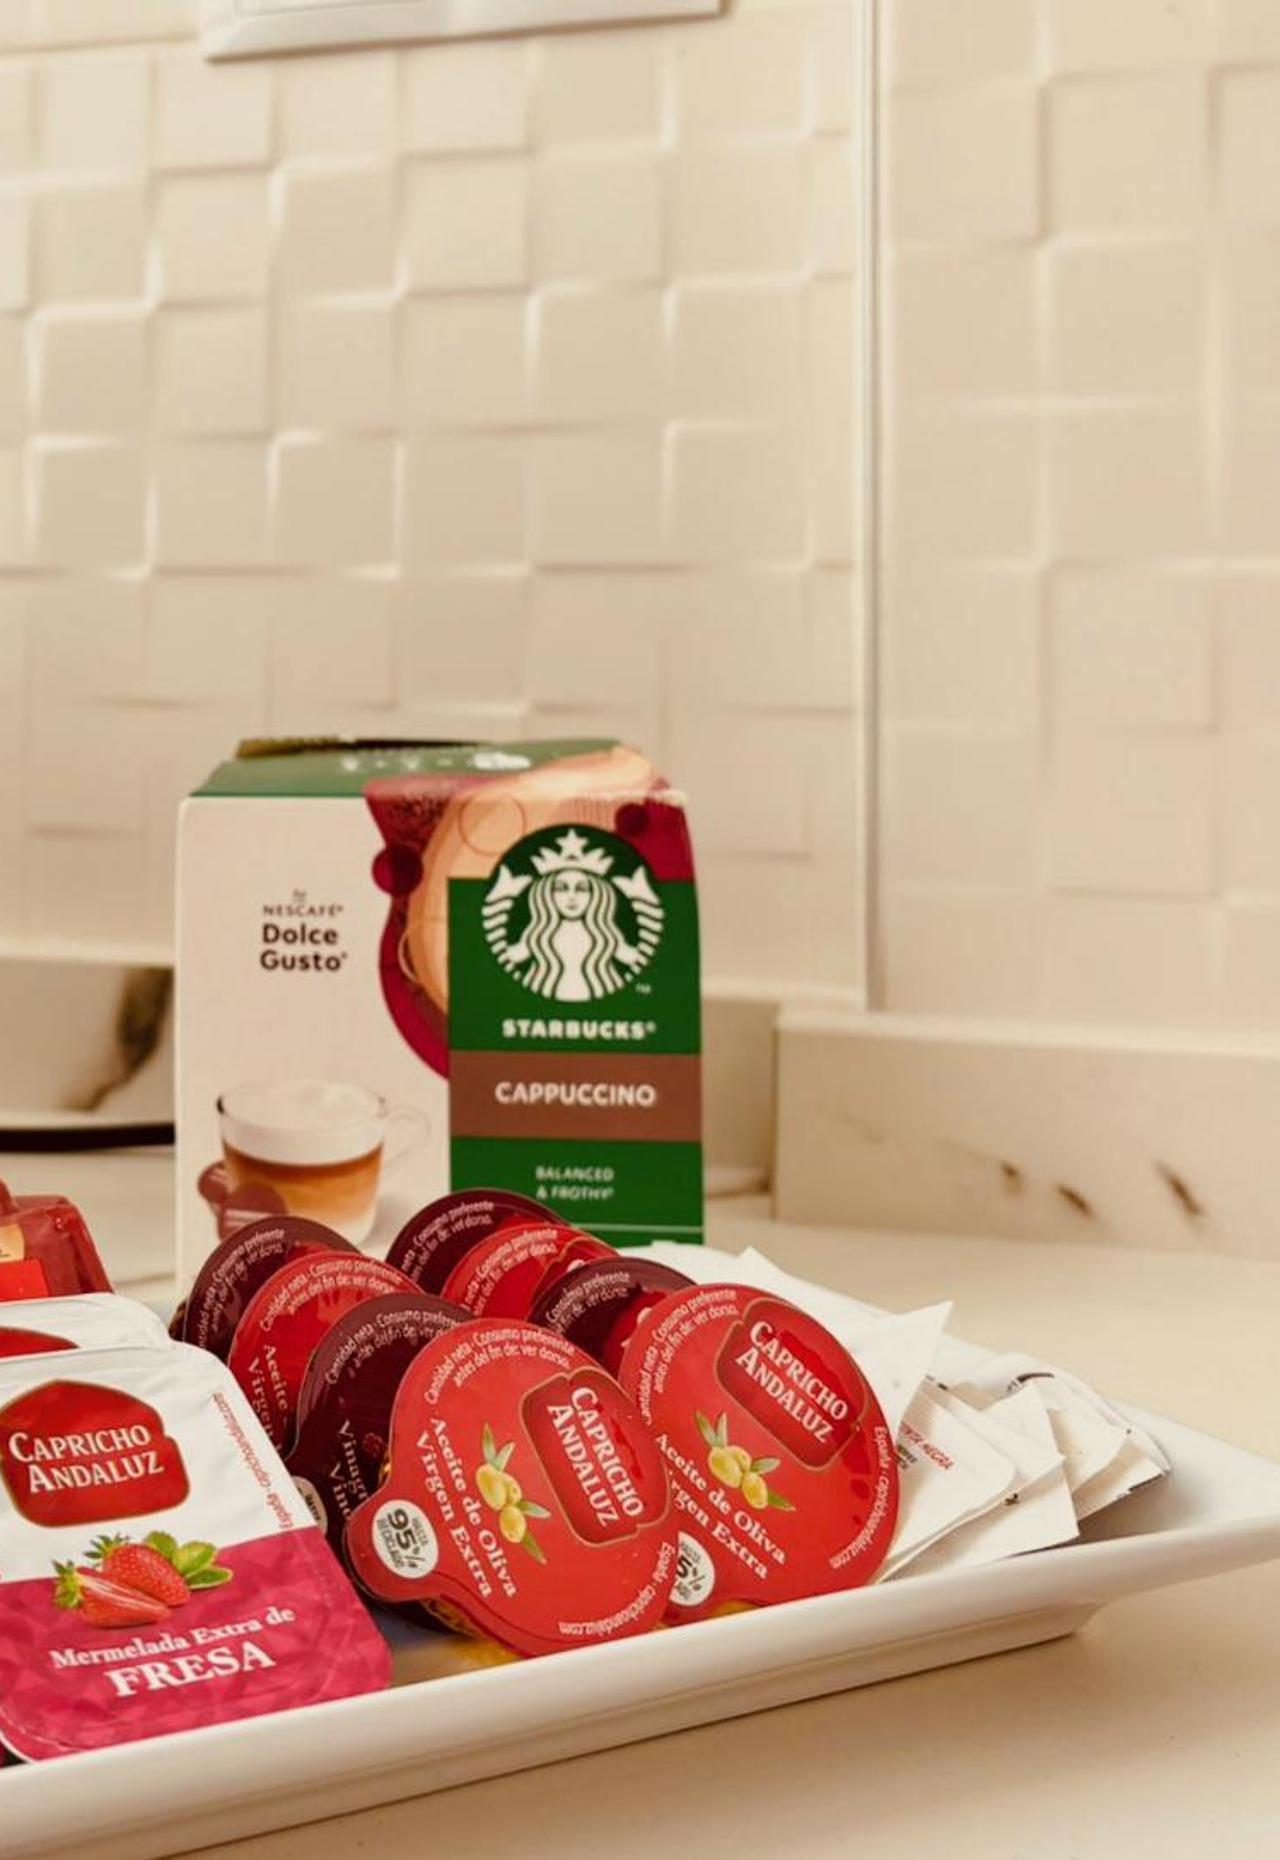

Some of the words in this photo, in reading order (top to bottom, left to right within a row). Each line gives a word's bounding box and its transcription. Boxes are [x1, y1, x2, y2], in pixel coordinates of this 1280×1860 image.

[260, 949, 341, 971] Gusto
[263, 922, 338, 945] Dolce
[494, 1081, 657, 1107] CAPPUCCINO
[535, 1165, 615, 1182] BALANCED
[536, 1185, 548, 1200] &
[736, 1346, 834, 1443] ANDALUZ
[750, 1321, 848, 1420] CAPRICHO
[8, 1424, 151, 1463] CAPRICHO
[28, 1451, 165, 1494] ANDALUZ
[338, 1419, 368, 1500] Vinagr
[547, 1405, 619, 1527] ANDALUZ
[572, 1387, 644, 1516] CAPRICHO
[416, 1430, 454, 1522] Virgen
[450, 1525, 492, 1598] Extra
[430, 1417, 466, 1492] Aceite
[462, 1496, 482, 1526] de
[478, 1529, 517, 1597] Oliva
[655, 1433, 707, 1491] Aceite
[708, 1487, 731, 1514] de
[734, 1510, 786, 1565] Oliva
[387, 1508, 426, 1569] 95%
[711, 1522, 768, 1579] Extra
[676, 1555, 706, 1591] 5%
[50, 1632, 191, 1669] Mermelada
[191, 1618, 263, 1645] Extra
[266, 1606, 296, 1625] de
[104, 1640, 276, 1697] FRESA
